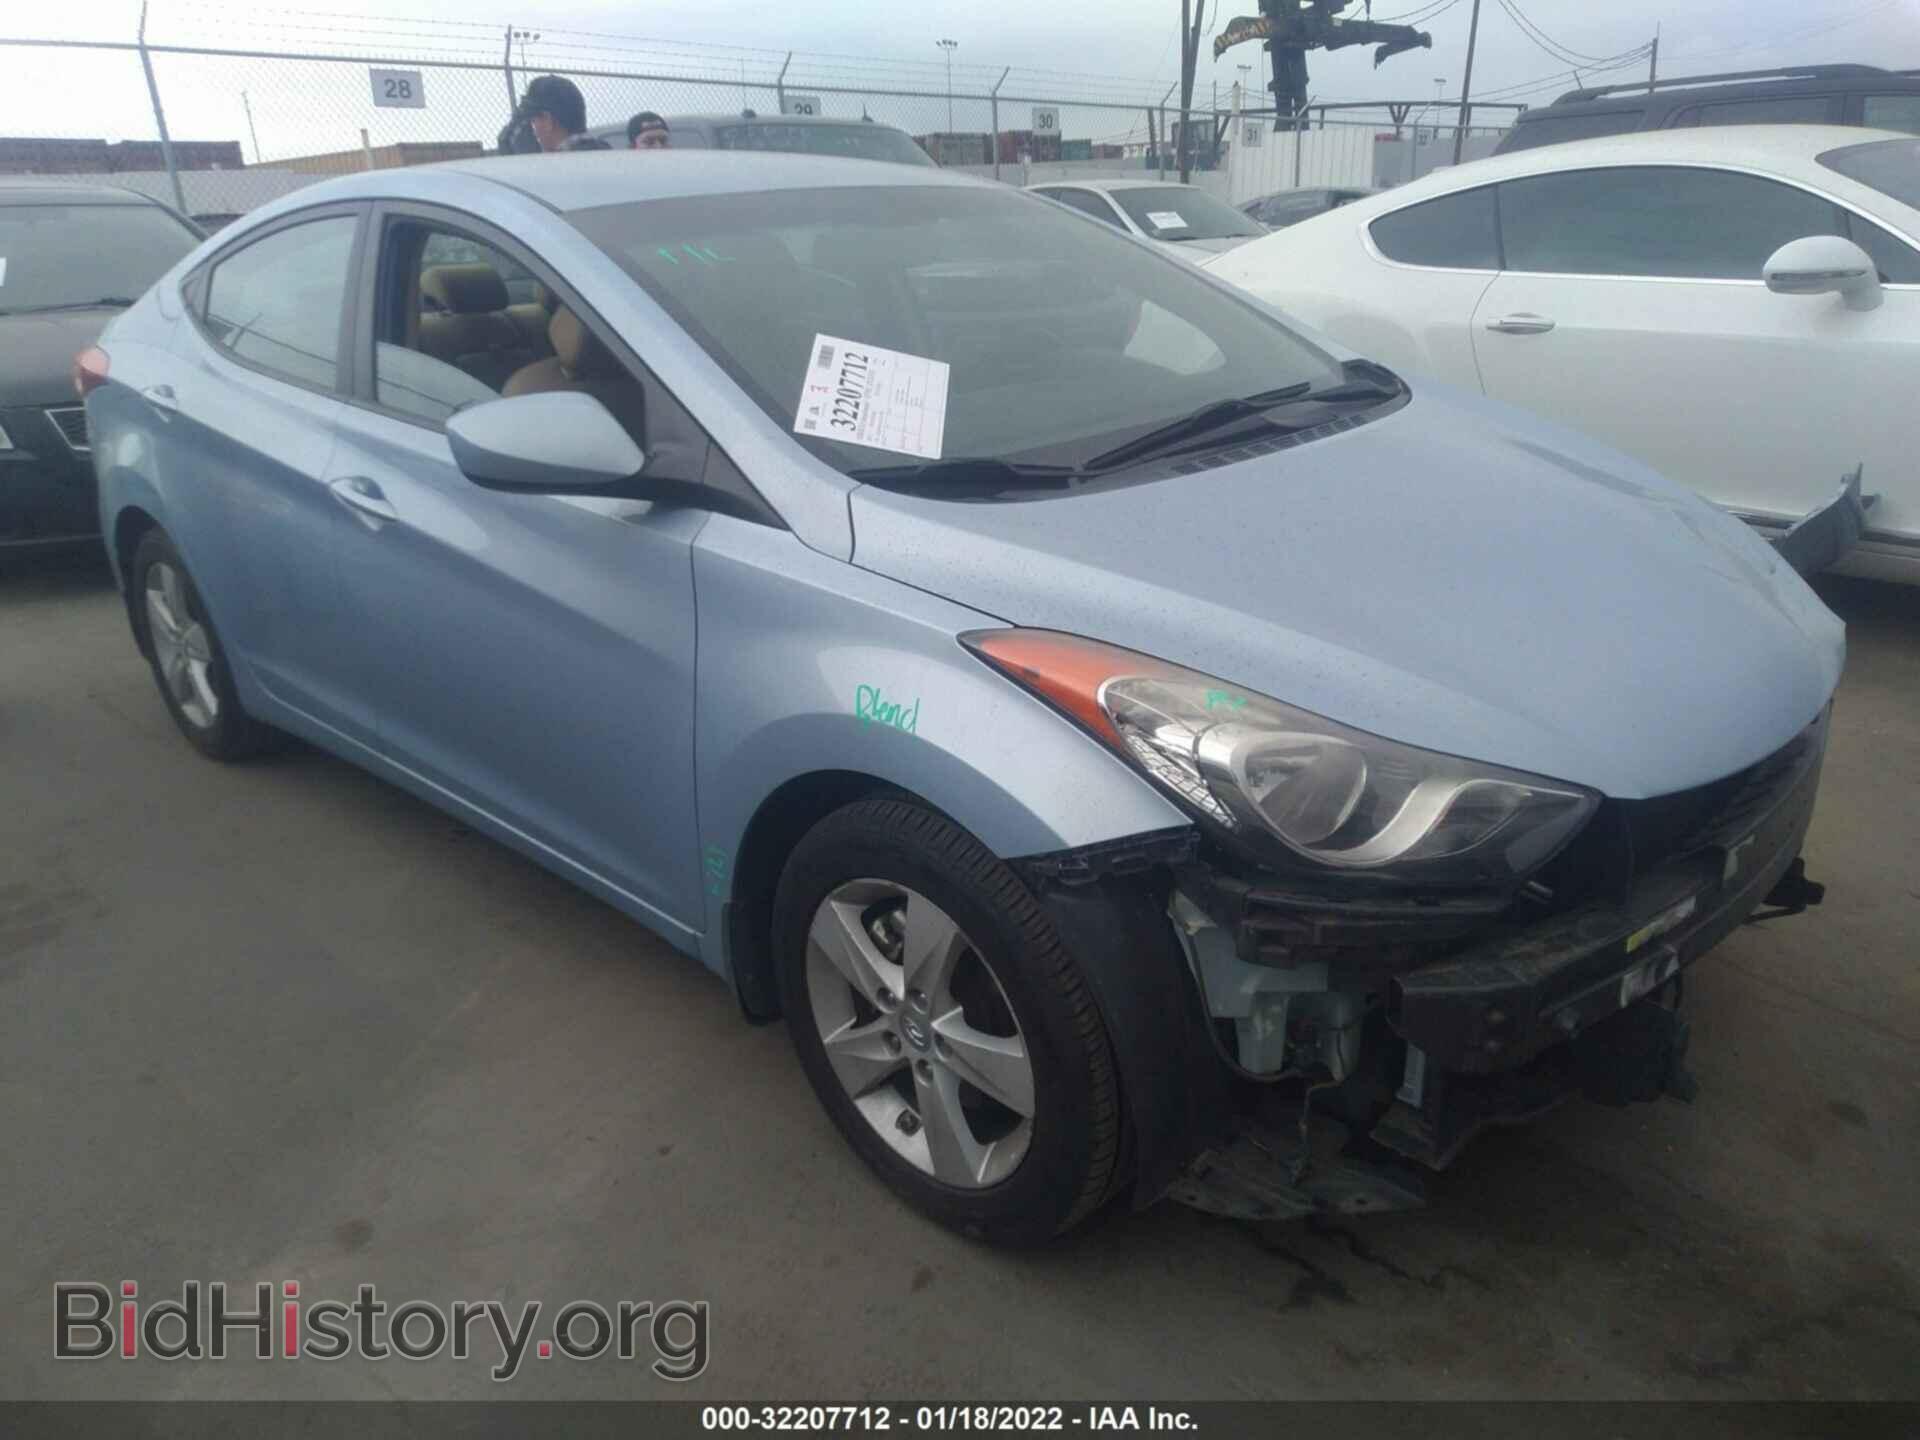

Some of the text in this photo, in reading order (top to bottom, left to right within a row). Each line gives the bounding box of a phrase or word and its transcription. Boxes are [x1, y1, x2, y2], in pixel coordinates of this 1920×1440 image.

[384, 79, 411, 99] 28
[1039, 113, 1053, 129] 30
[830, 352, 869, 431] 32207712
[855, 683, 921, 738] Blend
